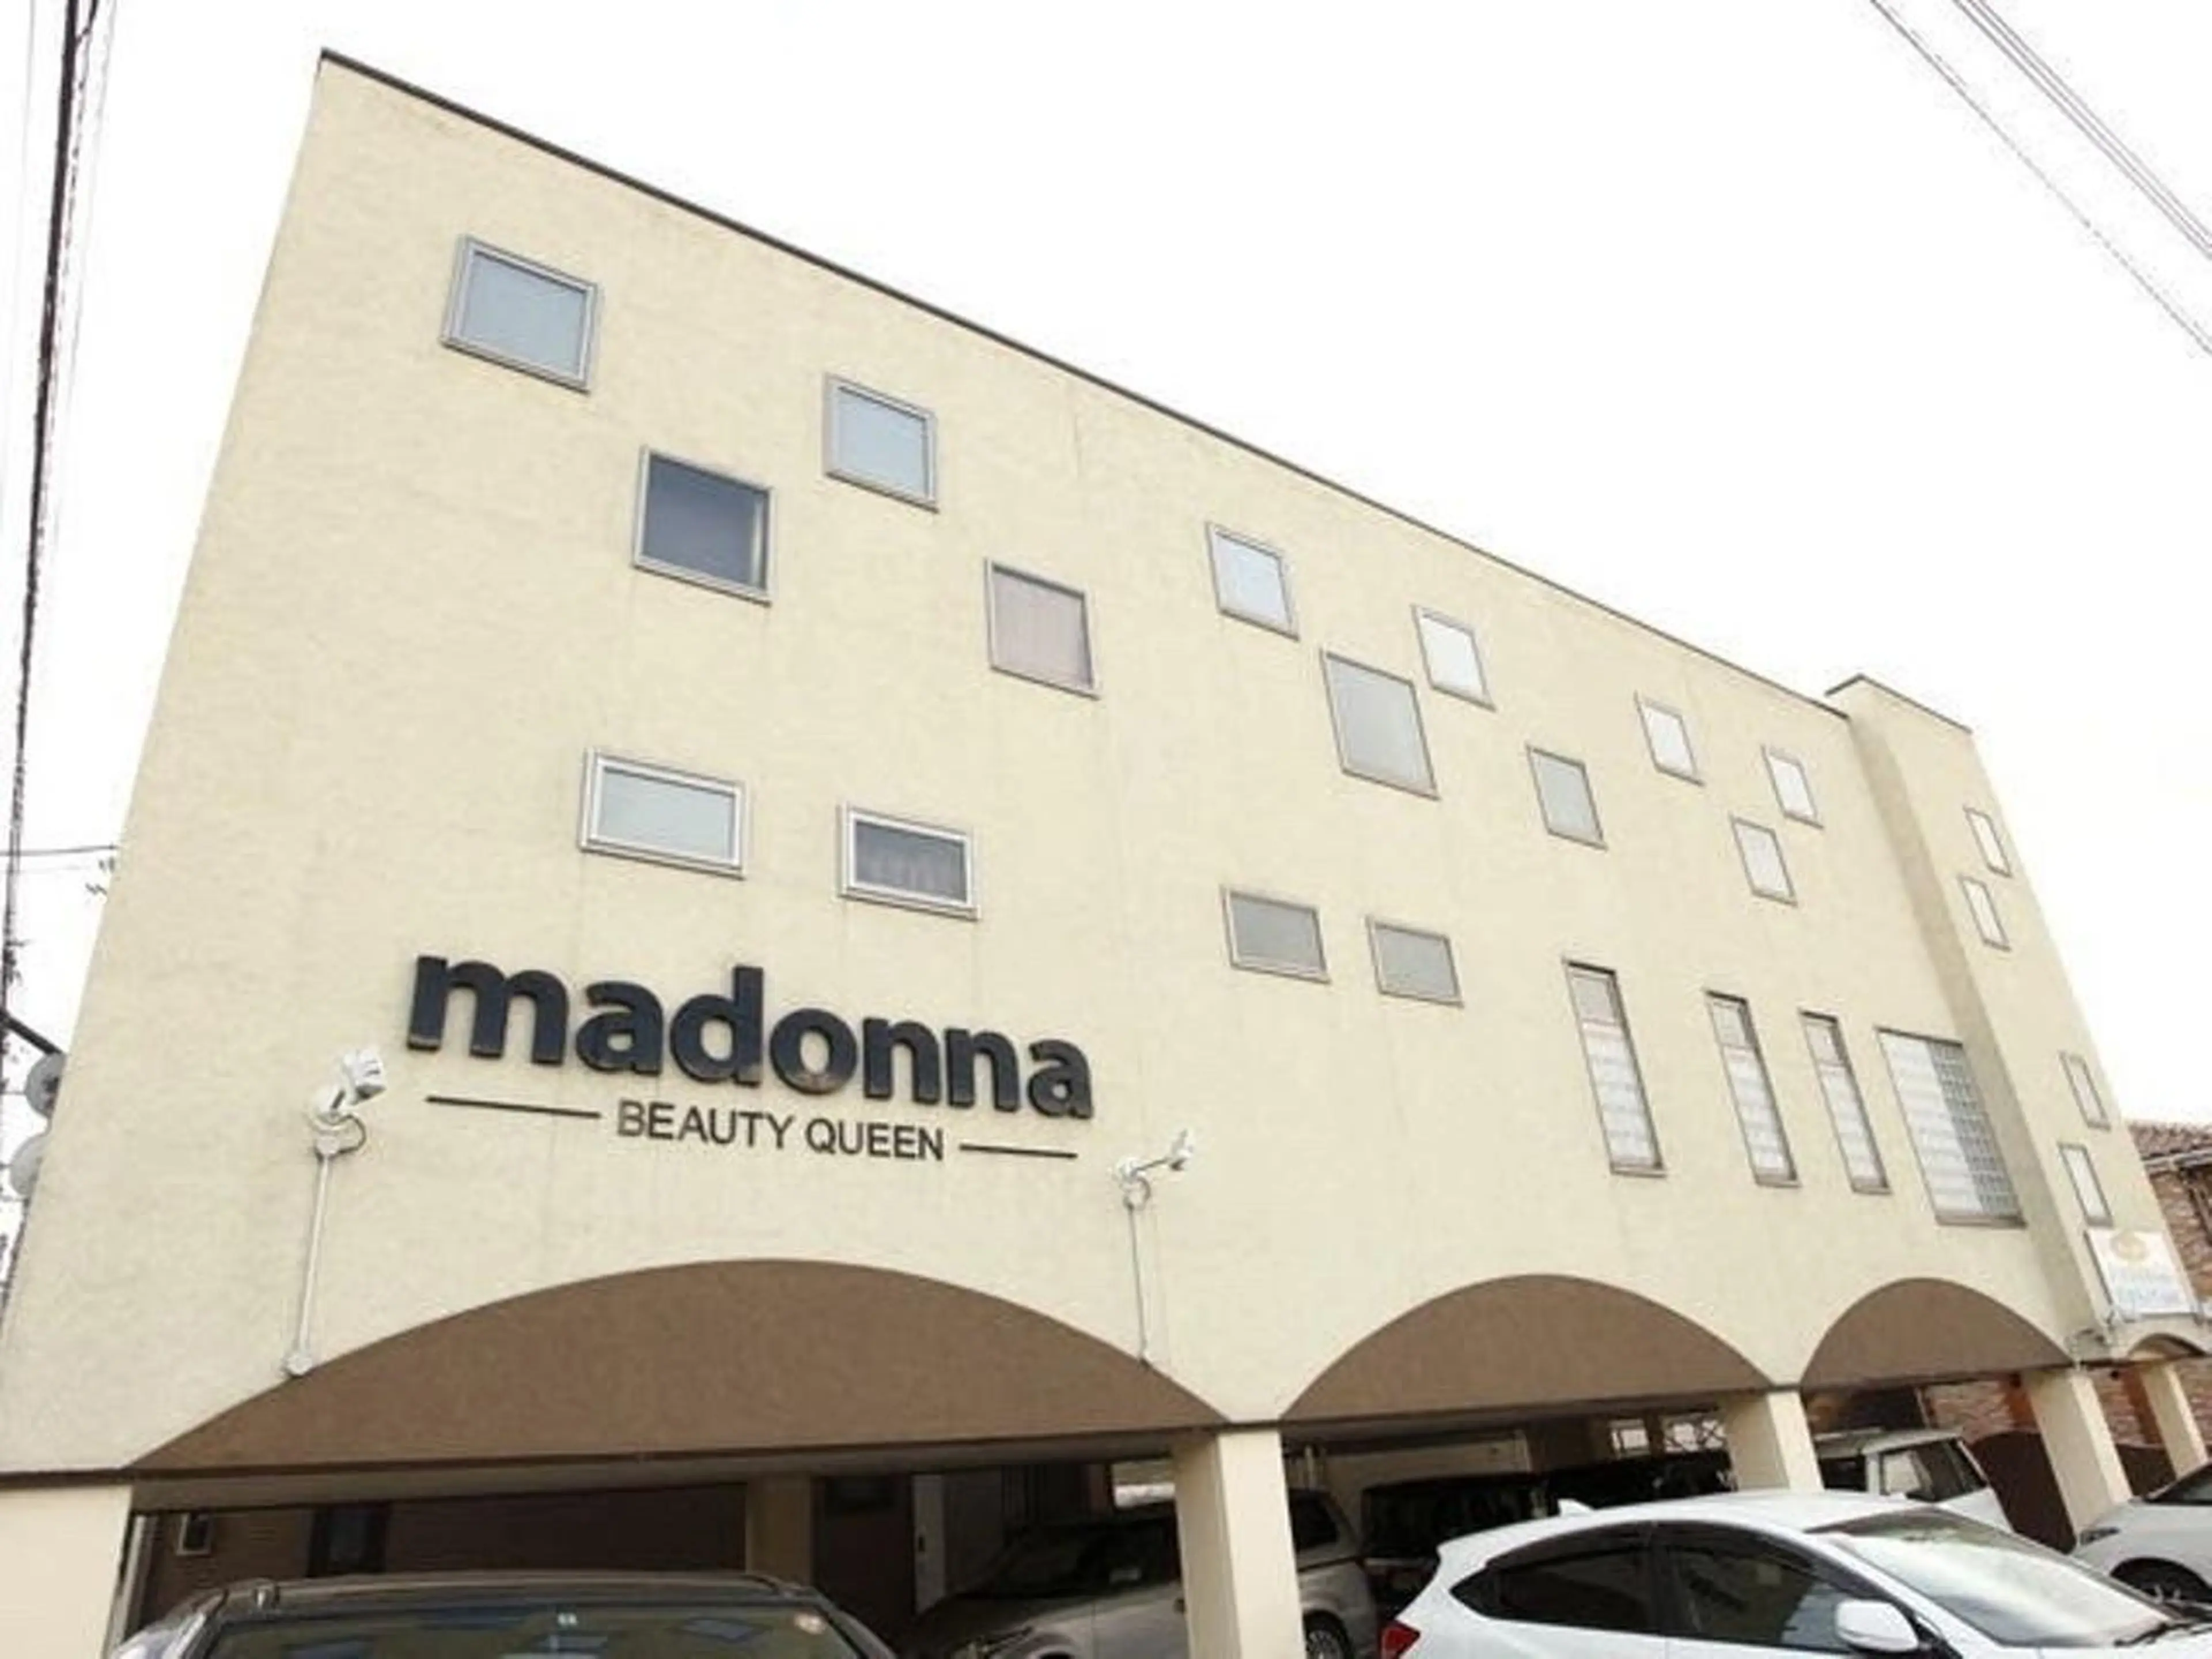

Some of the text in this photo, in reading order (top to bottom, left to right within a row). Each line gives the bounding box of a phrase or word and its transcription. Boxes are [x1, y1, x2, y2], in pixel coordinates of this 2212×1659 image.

[406, 955, 1093, 1121] madonna
[617, 1100, 944, 1161] BEAUTY QUEEN
